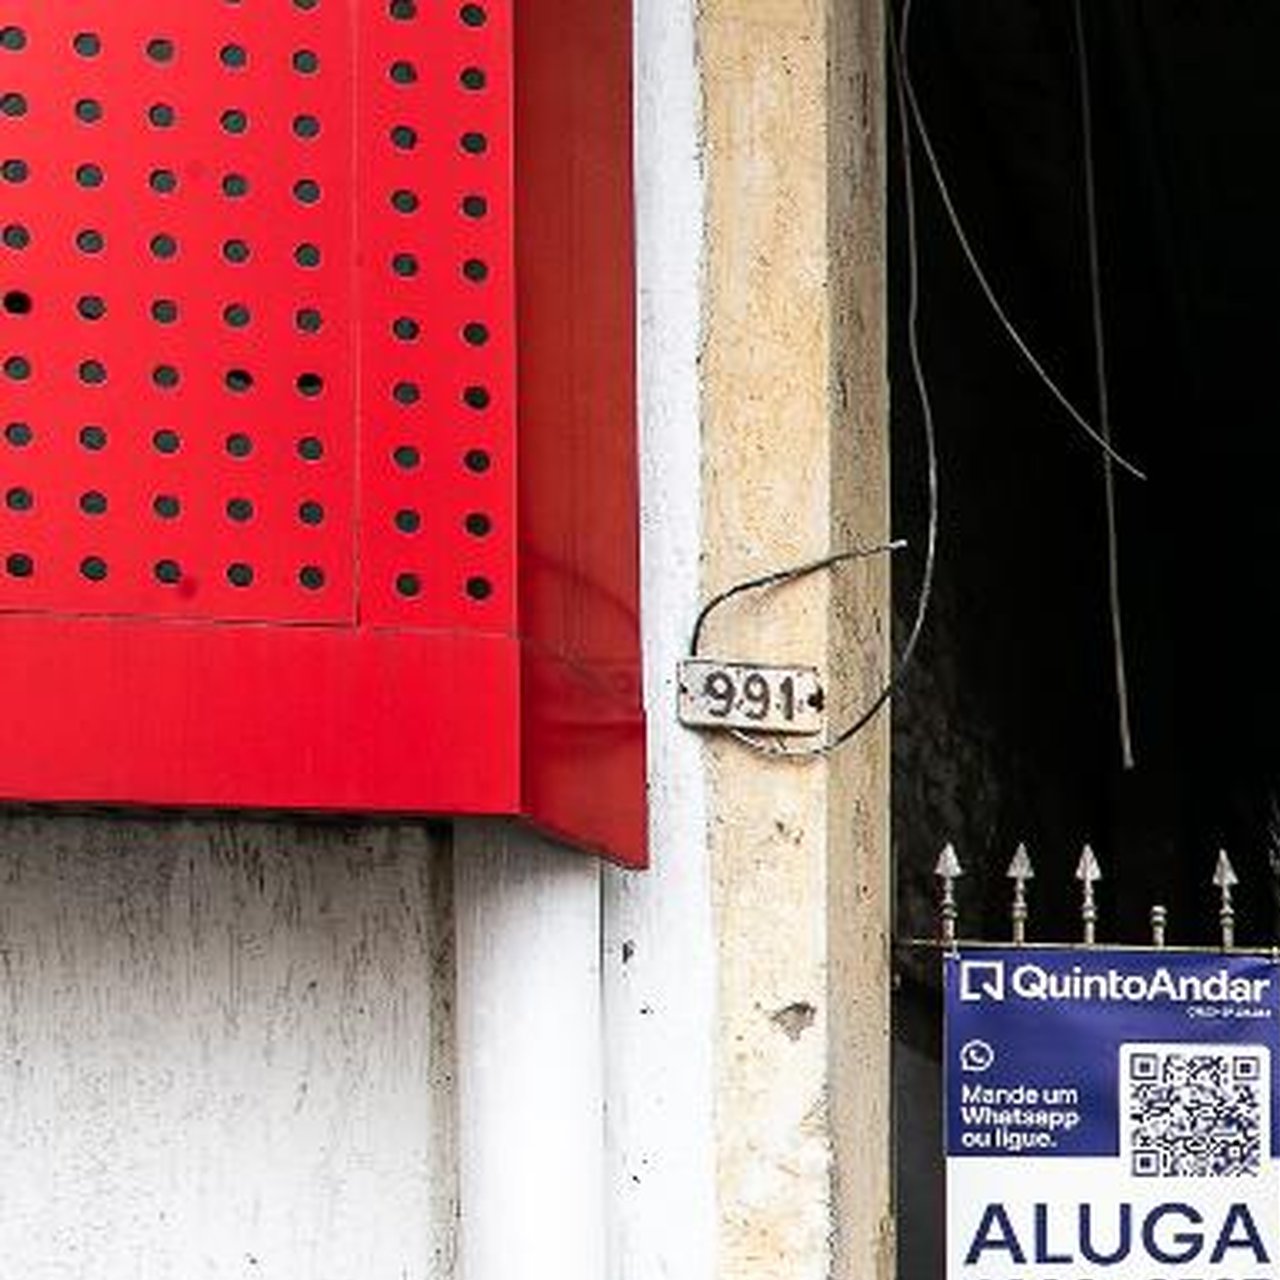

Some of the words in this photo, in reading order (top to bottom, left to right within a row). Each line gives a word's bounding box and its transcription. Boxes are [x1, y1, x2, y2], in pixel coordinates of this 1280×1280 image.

[703, 670, 795, 721] 991
[1012, 964, 1271, 1001] QuintoAndar
[961, 1084, 1039, 1105] Mande
[1042, 1088, 1079, 1105] um
[961, 1106, 1080, 1131] Whatsapp
[961, 1132, 992, 1148] ou
[995, 1129, 1057, 1152] ligue.
[963, 1202, 1271, 1266] ALUGA
